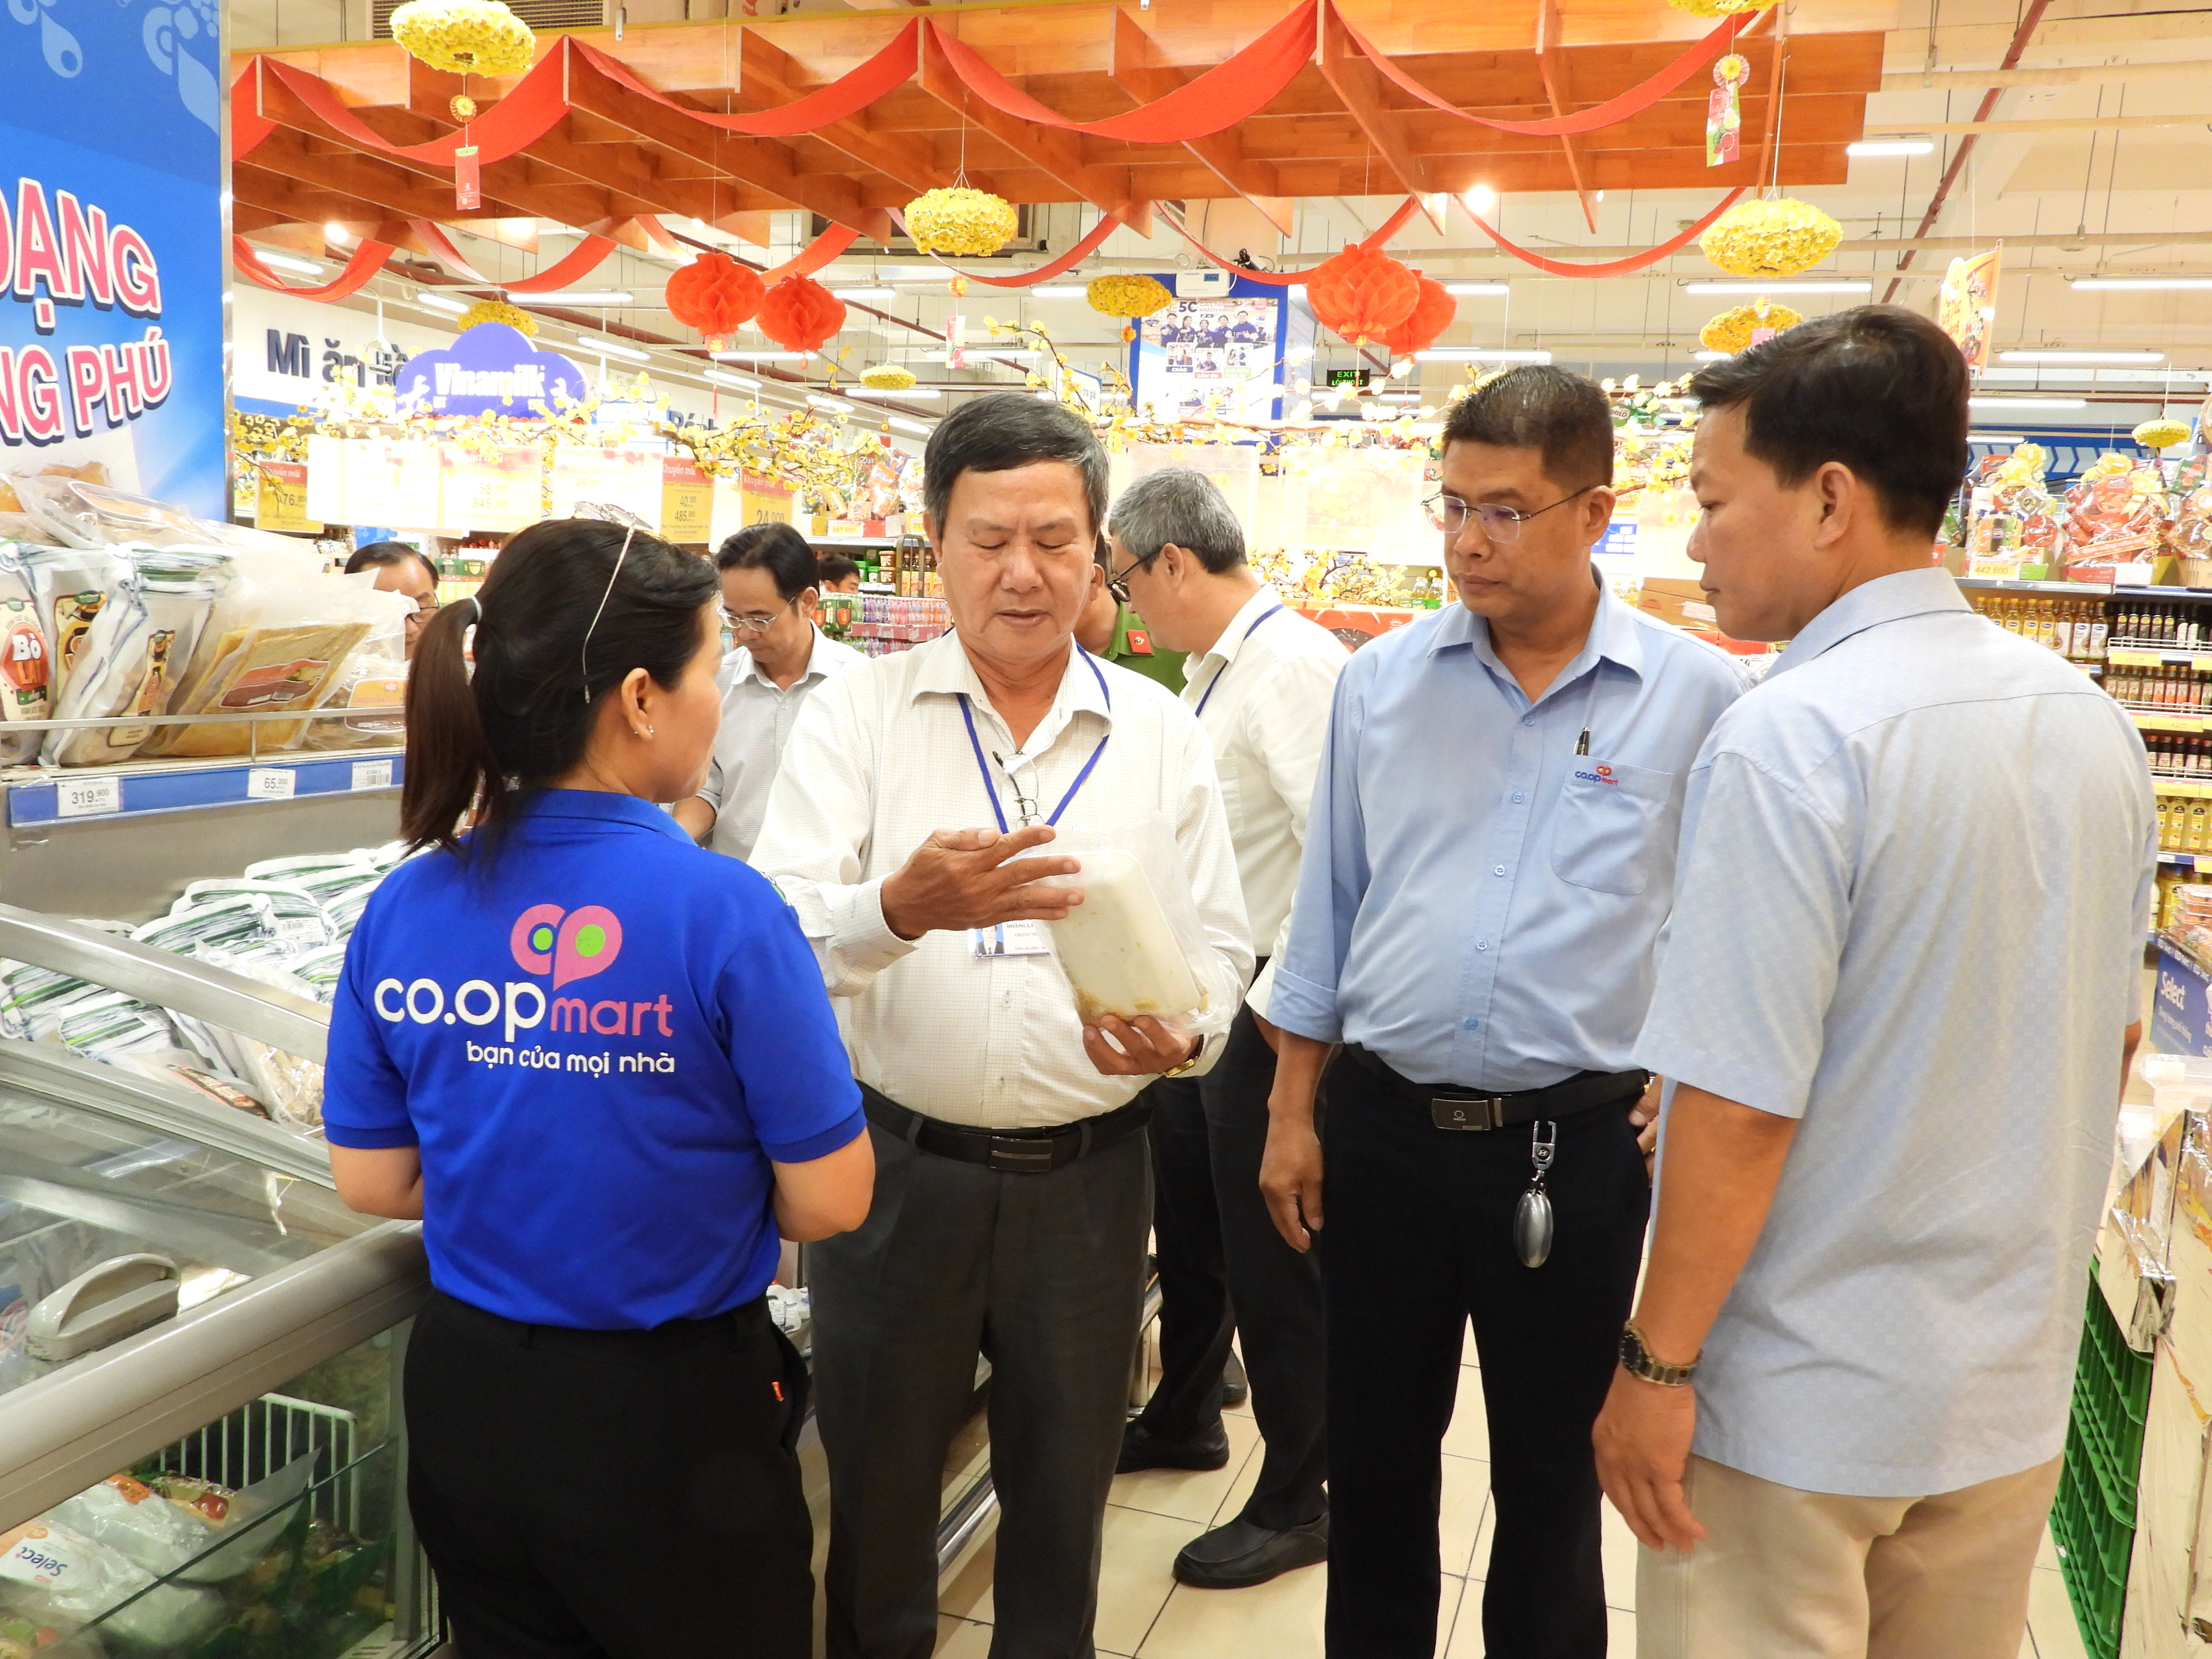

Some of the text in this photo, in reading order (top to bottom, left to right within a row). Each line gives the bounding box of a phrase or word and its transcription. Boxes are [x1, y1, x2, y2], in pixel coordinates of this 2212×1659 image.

[0, 177, 162, 330] ẠNG
[267, 329, 310, 378] Mì
[66, 326, 172, 434] PHÚ
[434, 363, 545, 397] Vinamilk
[466, 1040, 675, 1079] bạn của mọi nhà
